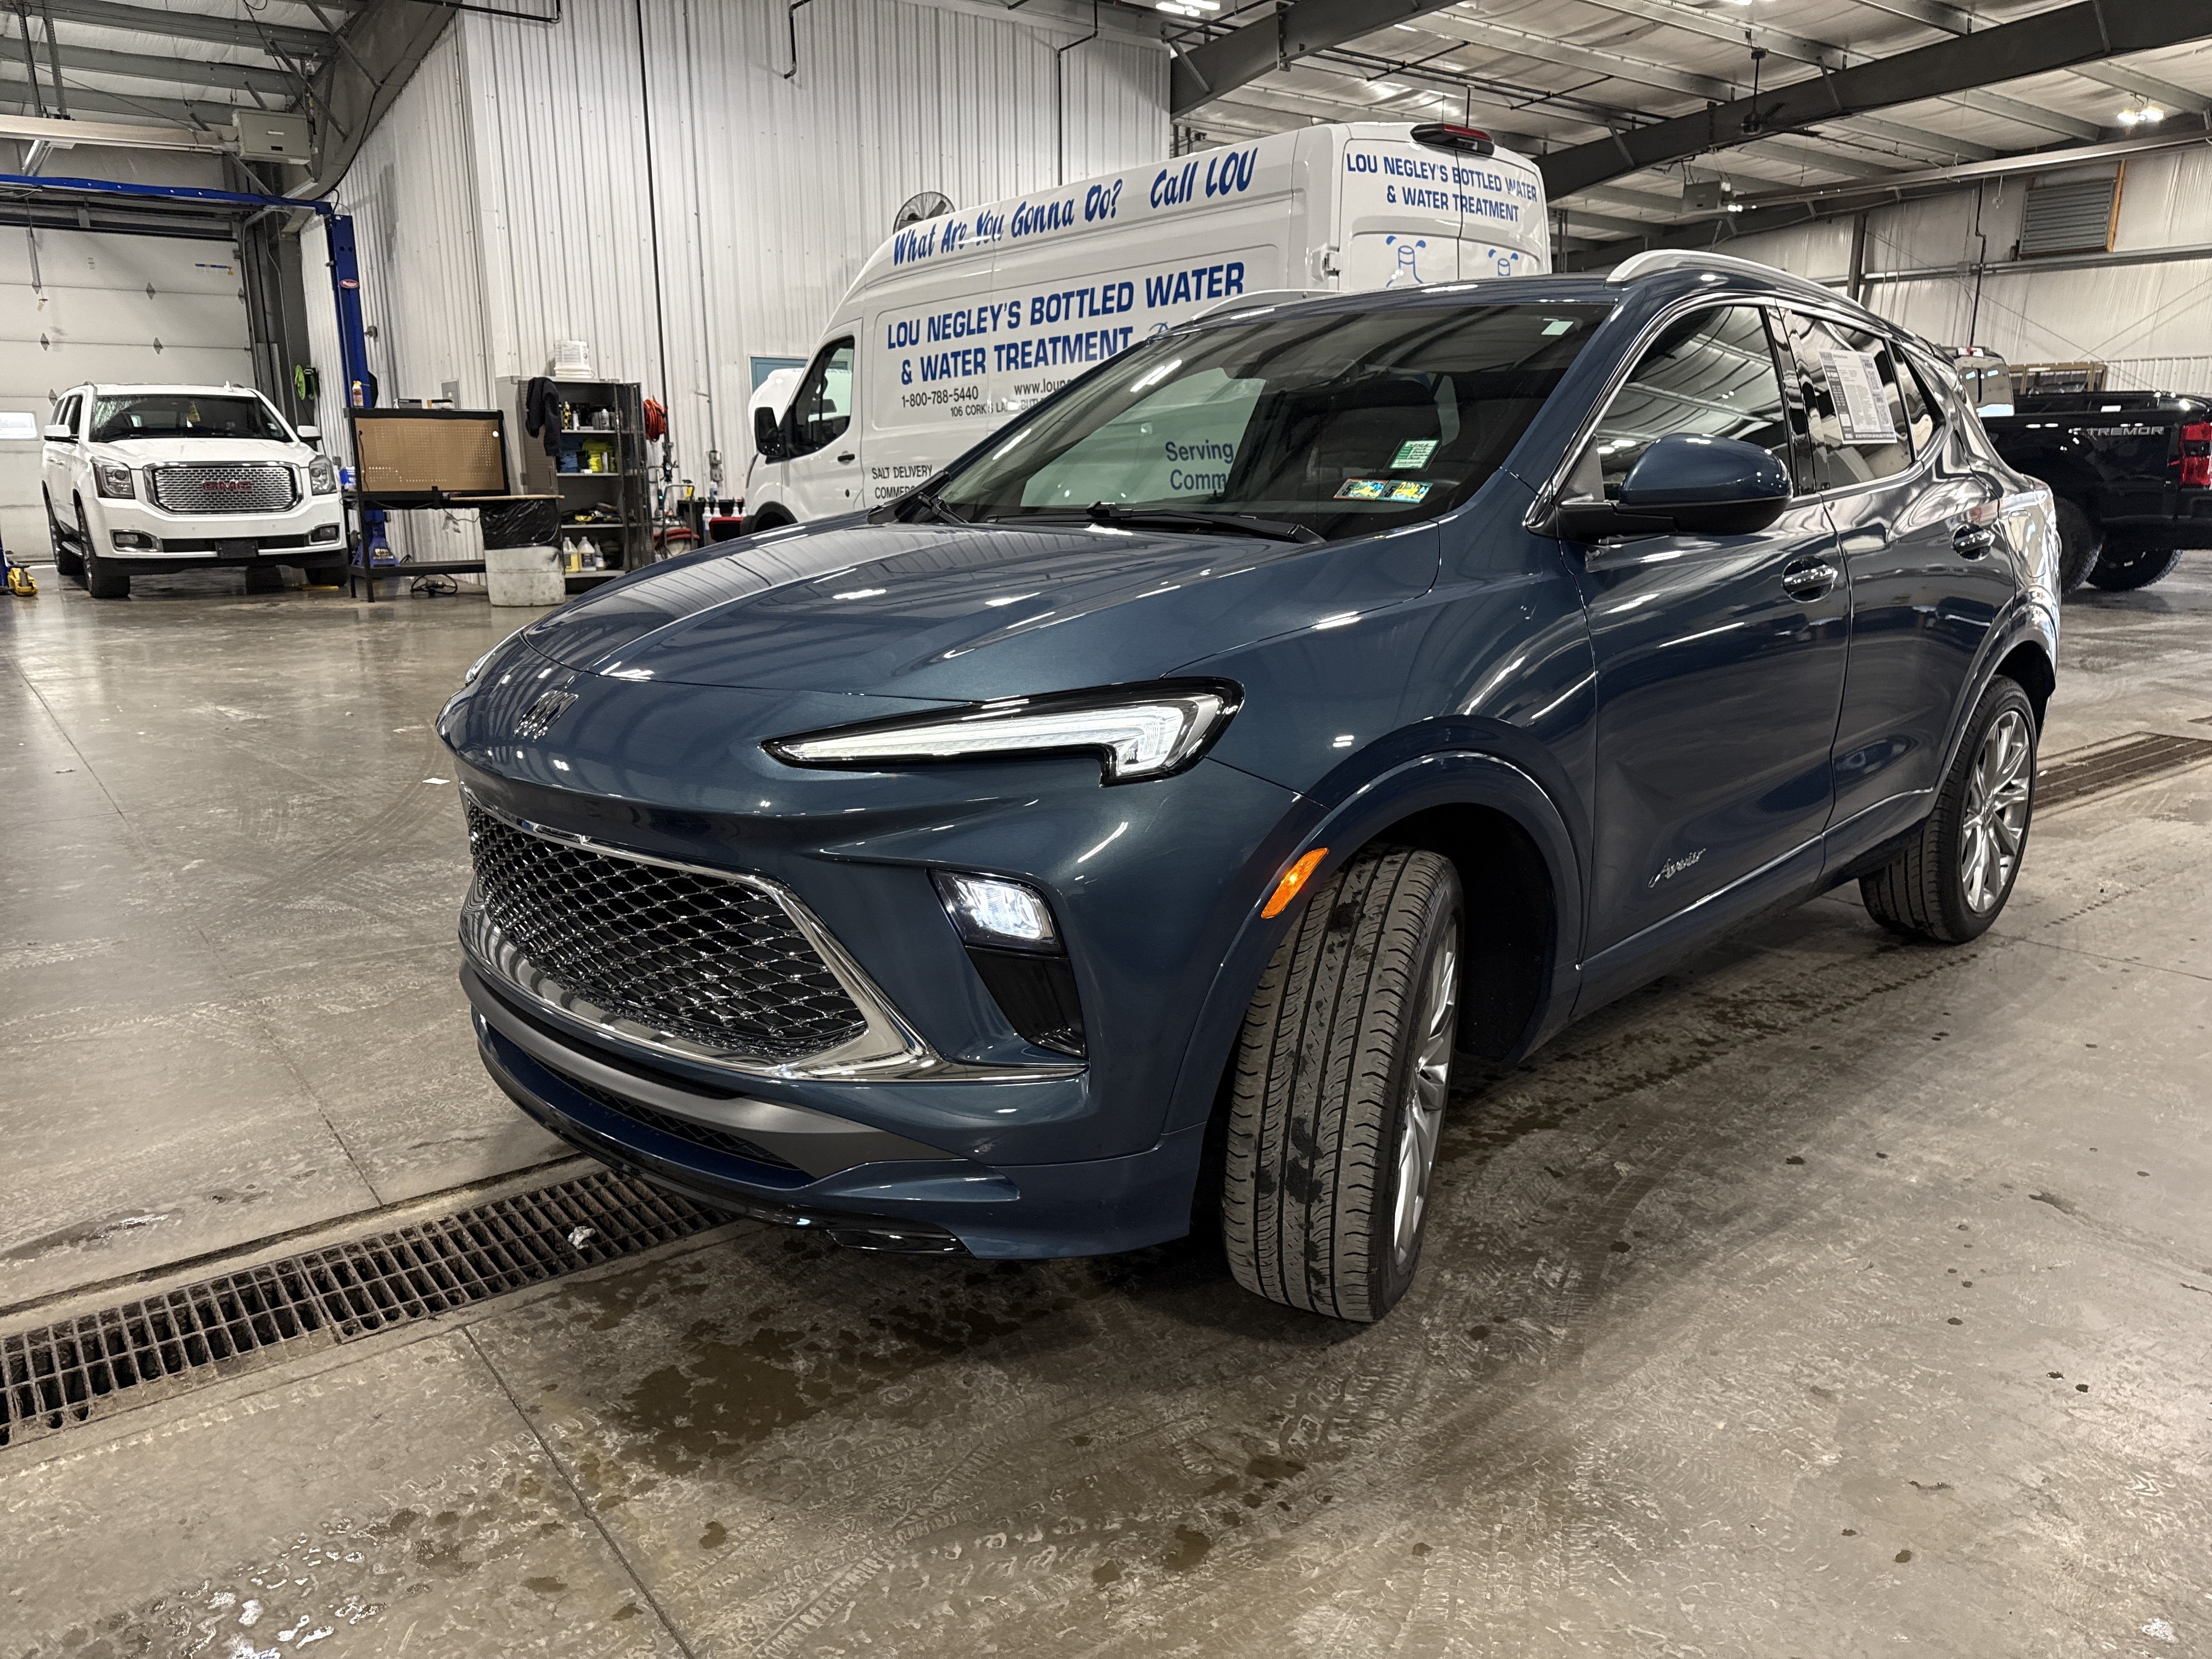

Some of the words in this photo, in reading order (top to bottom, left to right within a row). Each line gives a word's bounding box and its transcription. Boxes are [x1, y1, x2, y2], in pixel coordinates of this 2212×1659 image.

[1347, 153, 1378, 173] LOU
[1384, 156, 1448, 183] NEGLEY'S
[1452, 167, 1502, 192] BOTTLED
[1505, 177, 1537, 202] WATER
[894, 223, 936, 266] What
[941, 219, 967, 254] Are
[976, 210, 1005, 246] You
[1011, 201, 1075, 238] Gonna
[1085, 178, 1123, 222] Do?
[1150, 161, 1199, 208] Call
[1205, 147, 1259, 198] LOU
[1386, 185, 1396, 204] &
[1402, 187, 1449, 211] WATER
[1453, 194, 1519, 222] TREATMENT
[887, 319, 920, 349] LOU
[927, 301, 1022, 342] NEGLEY'S
[1030, 281, 1134, 326] BOTTLED
[1146, 262, 1244, 308] WATER
[901, 359, 912, 385] &
[920, 347, 986, 382] WATER
[994, 326, 1133, 372] TREATMENT
[901, 386, 979, 408] 1-800-788-5440
[1014, 379, 1072, 396] www.loun
[950, 407, 963, 417] 106
[2086, 426, 2165, 436] TREMOR
[1165, 439, 1234, 464] Serving
[872, 467, 890, 479] SALT
[894, 465, 933, 478] DELIVERY
[1170, 469, 1229, 490] Comm
[202, 480, 252, 491] GMC
[874, 485, 915, 499] COMMER
